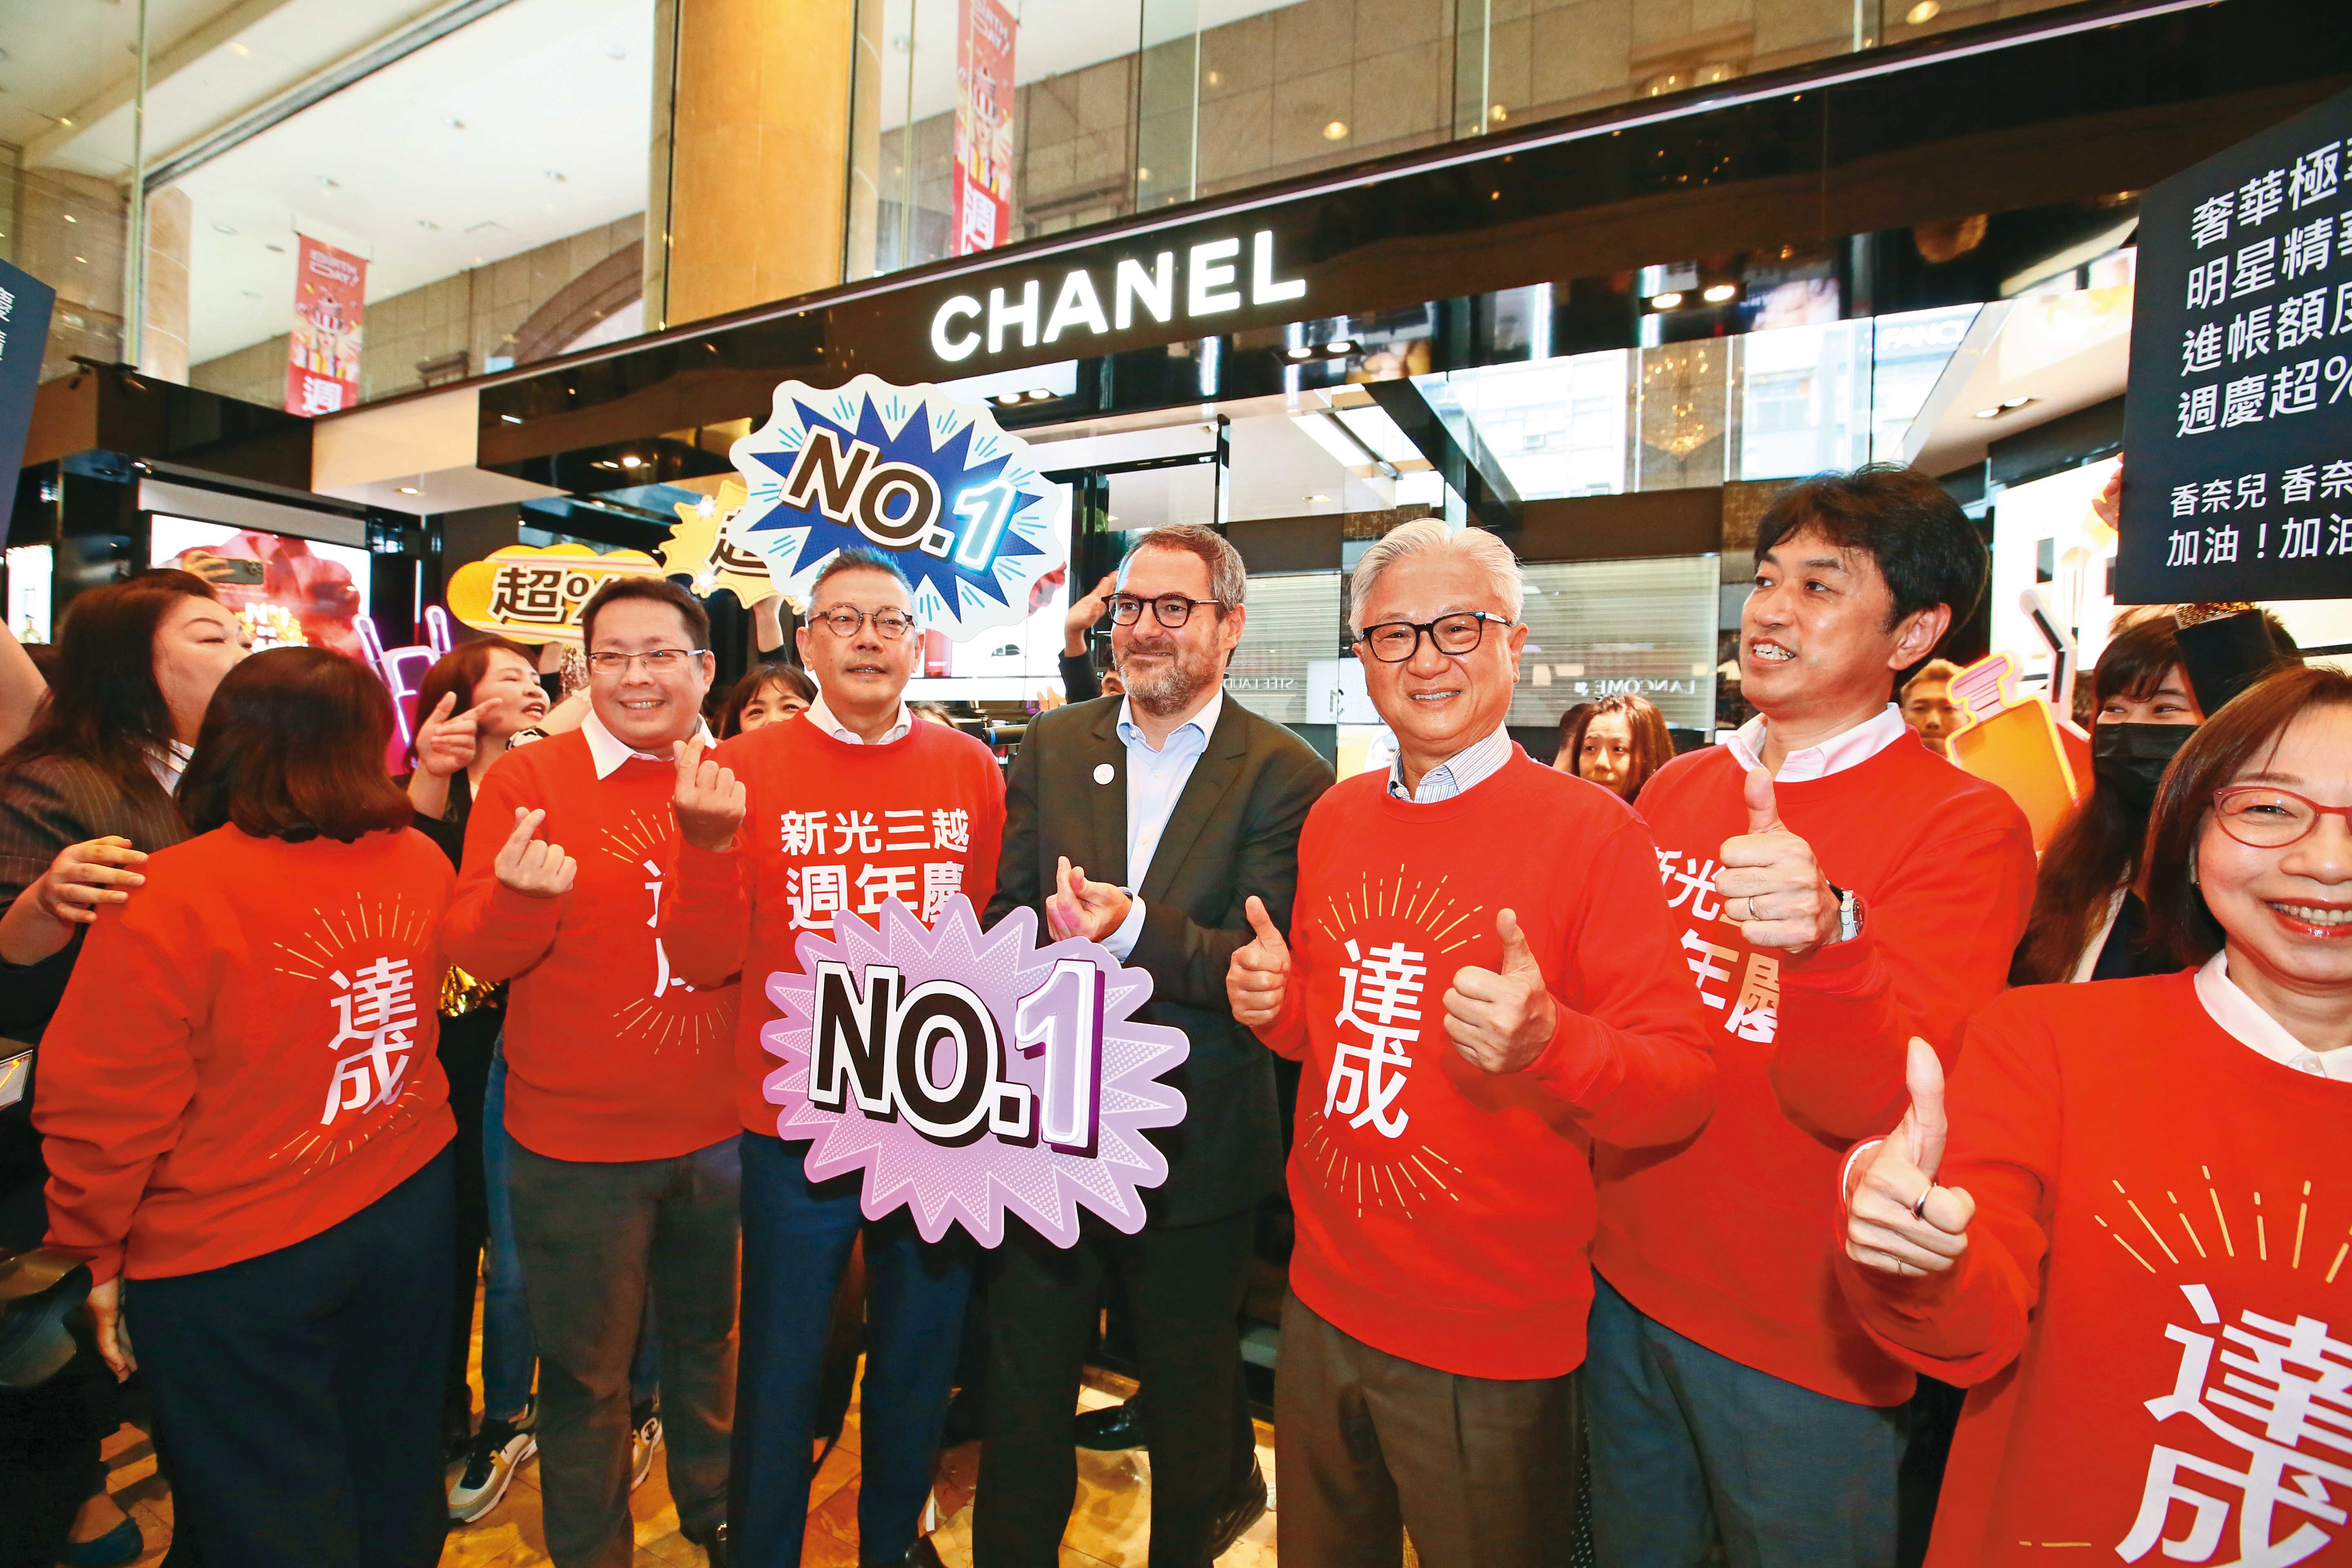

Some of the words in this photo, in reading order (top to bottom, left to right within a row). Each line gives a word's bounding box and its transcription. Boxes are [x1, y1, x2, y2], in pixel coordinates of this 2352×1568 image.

[963, 182, 996, 252] 週
[2191, 137, 2352, 249] 奢華極
[931, 230, 1306, 361] CHANEL
[777, 424, 1019, 576] NO.1
[2170, 472, 2267, 518] 香奈兒
[2281, 459, 2352, 504] 香奈
[780, 808, 969, 856] 新光三越
[786, 861, 964, 931] 週年慶
[320, 956, 417, 1126] 達成
[808, 958, 1105, 1159] NO.1
[1323, 938, 1427, 1138] 達成
